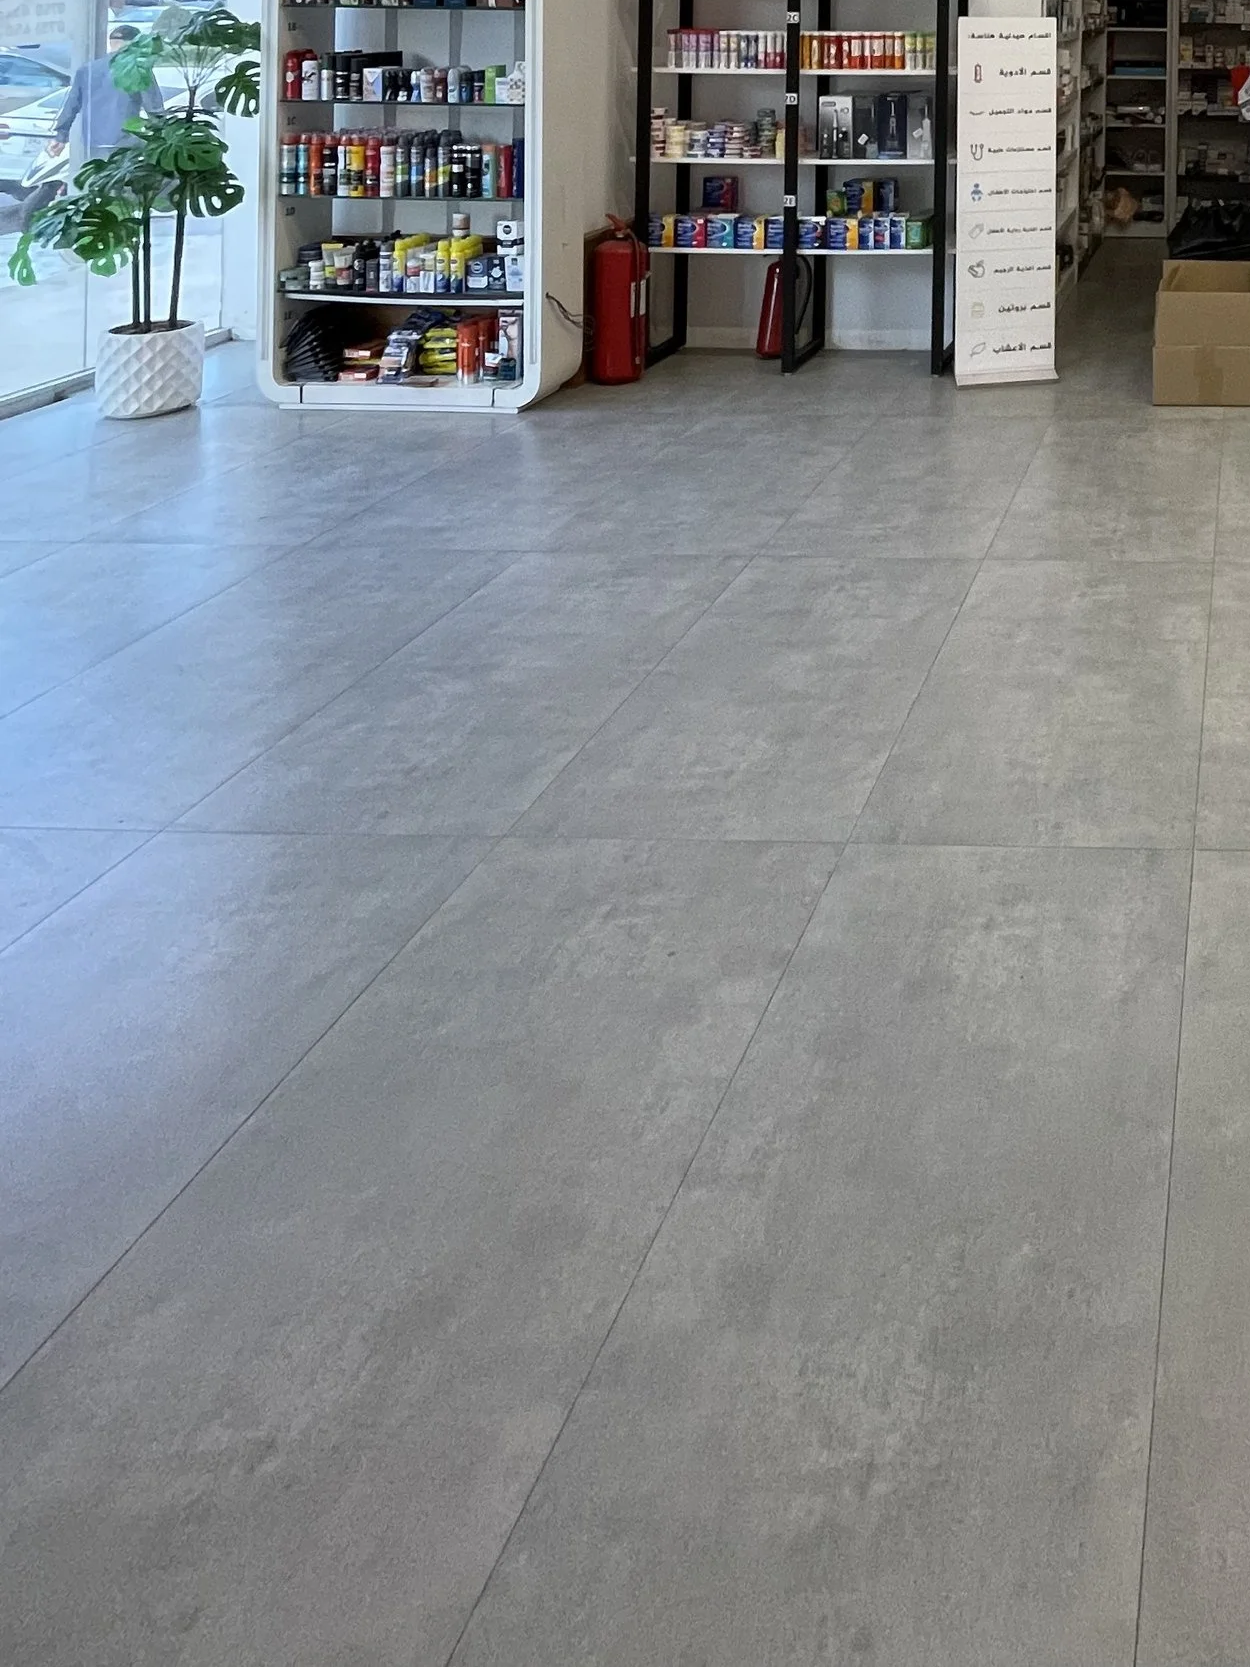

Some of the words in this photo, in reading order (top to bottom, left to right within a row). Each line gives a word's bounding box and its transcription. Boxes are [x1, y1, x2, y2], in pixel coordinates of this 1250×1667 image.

[1030, 68, 1051, 76] قسم
[1030, 301, 1051, 310] قسم
[1030, 342, 1052, 352] قسم
